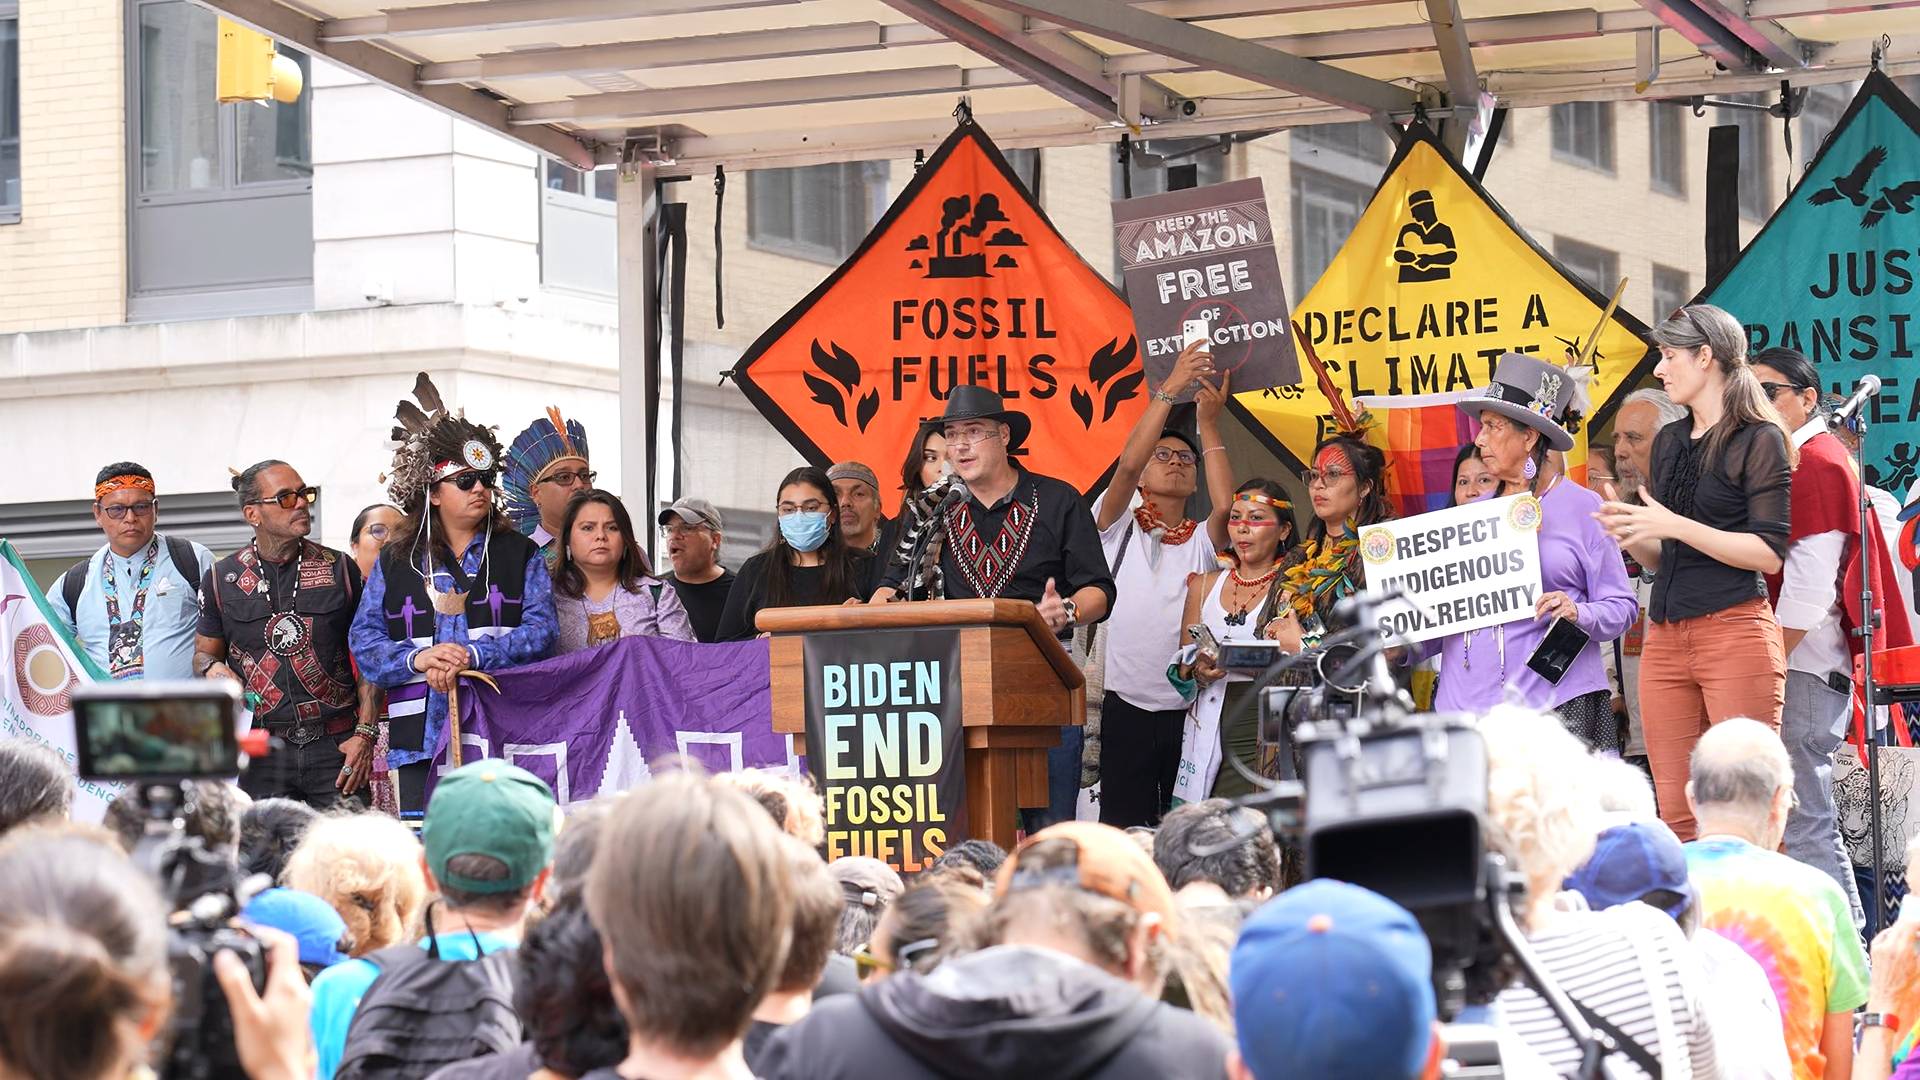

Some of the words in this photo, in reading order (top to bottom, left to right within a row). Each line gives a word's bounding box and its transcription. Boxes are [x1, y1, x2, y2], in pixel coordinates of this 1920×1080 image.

[1136, 220, 1259, 262] AMAZON
[1155, 215, 1194, 233] KEEP
[1199, 209, 1229, 226] THE
[1156, 259, 1253, 304] FREE
[1809, 248, 1920, 299] JUS
[893, 297, 1056, 340] FOSSIL
[1200, 308, 1221, 321] OF
[1304, 297, 1498, 345] DECLARE
[1521, 293, 1549, 329] A
[1146, 318, 1285, 357] EXTCTION
[1743, 314, 1914, 363] RANSI
[893, 353, 1058, 401] FUELS
[1319, 344, 1540, 399] LIMAT
[1396, 516, 1500, 561] RESPECT
[1381, 548, 1525, 595] INDIGENOUS
[1378, 582, 1537, 639] SOVEREIGNTY
[823, 660, 941, 709] BIDEN
[824, 711, 943, 780] END
[1836, 758, 1854, 767] VIDA
[76, 777, 117, 804] UENC
[826, 783, 946, 825] FOSSIL
[827, 827, 947, 873] FUELS
